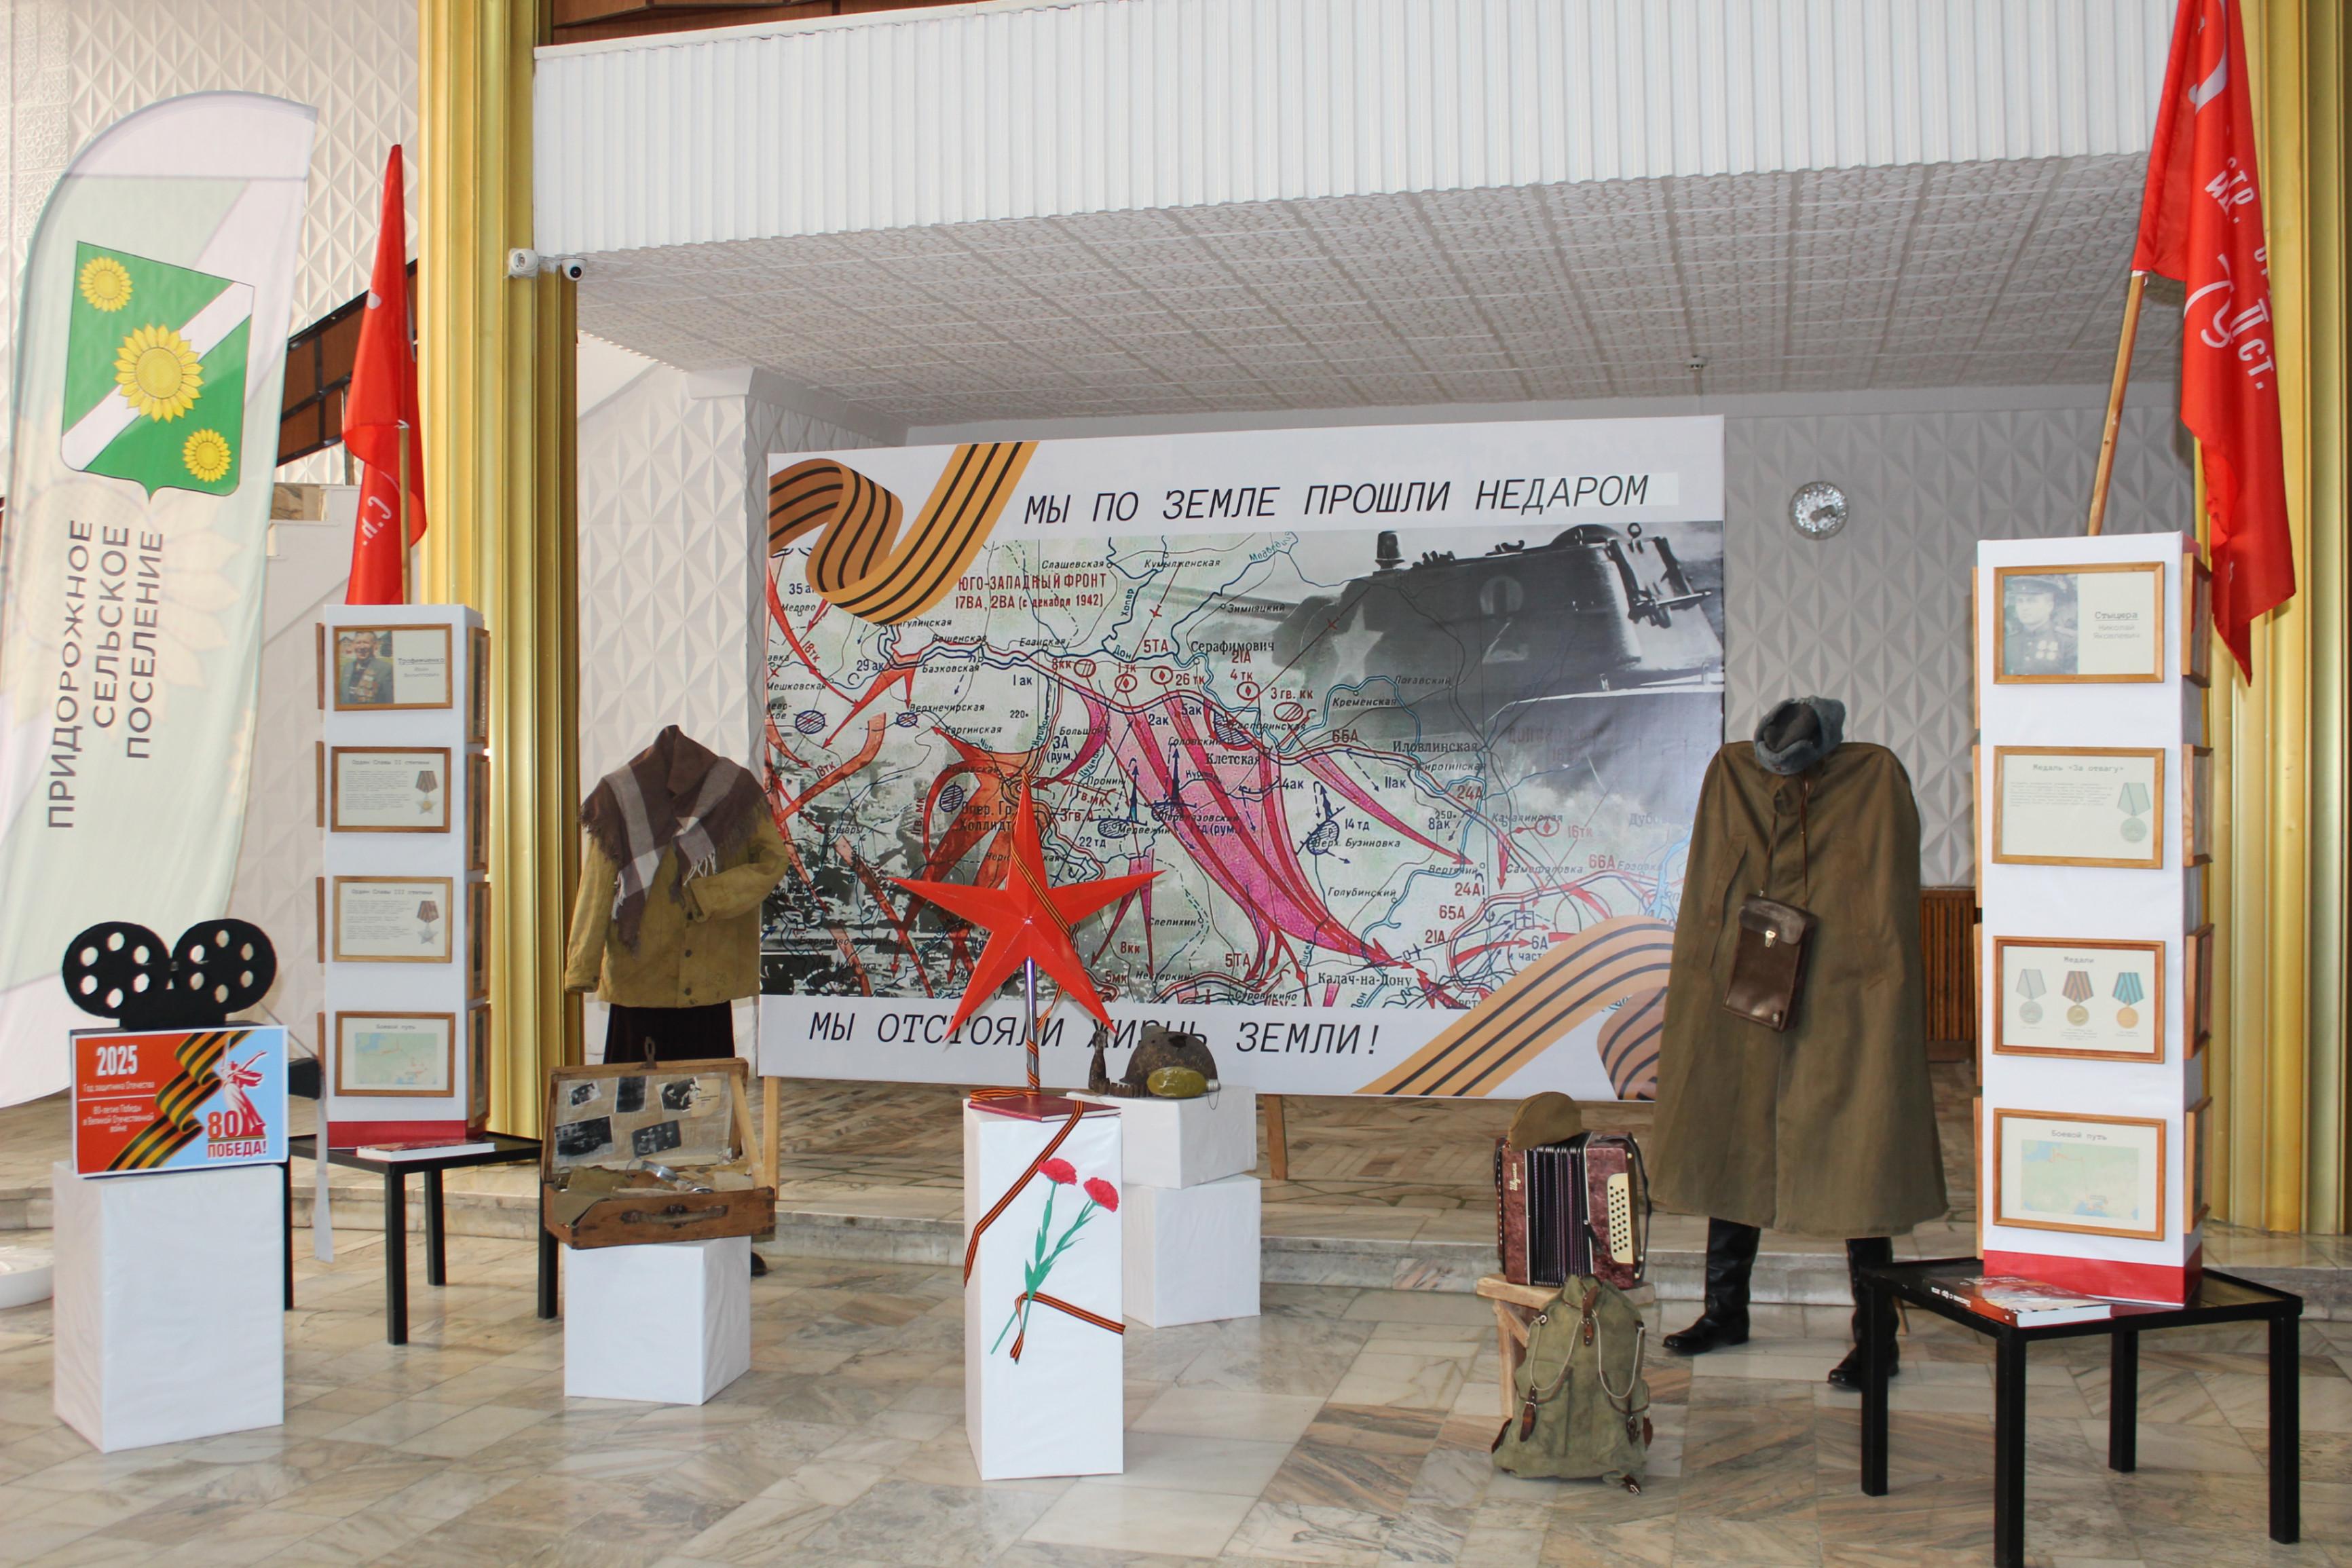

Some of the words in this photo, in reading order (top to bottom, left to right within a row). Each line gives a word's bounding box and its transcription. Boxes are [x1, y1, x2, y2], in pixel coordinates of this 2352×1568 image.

[1024, 494, 1071, 524] МЫ
[1092, 491, 1140, 522] ПО
[1163, 486, 1281, 521] ЗЕМЛЕ
[1304, 481, 1451, 515] ПРОШЛИ
[1474, 474, 1649, 515] НЕДАРОМ
[789, 583, 802, 594] 35
[958, 573, 1061, 591] ЮГО-ЗАПАДНЫЙ
[1064, 572, 1107, 589] ФРОНТ
[990, 595, 1015, 610] 2ВА
[1031, 594, 1070, 609] декабря
[1076, 592, 1103, 609] 1942)
[93, 525, 130, 728] СЕЛЬСКОЕ
[126, 531, 164, 759] ПОСЕЛЕНИЕ
[1113, 645, 1132, 660] Дон
[1143, 639, 1169, 654] 5ТА
[1191, 640, 1275, 654] Серафимович
[856, 660, 868, 671] 29
[48, 520, 93, 829] ПРИДОРОЖНОЕ
[1175, 673, 1190, 686] 26
[1332, 697, 1398, 707] Кременская
[1148, 714, 1170, 726] 2ак
[1393, 741, 1478, 753] Иловлинская
[1206, 753, 1261, 766] Клетская
[1079, 837, 1092, 847] 22
[1588, 854, 1616, 869] 66А
[1328, 886, 1396, 897] Голубинский
[1455, 882, 1480, 896] 24А
[1439, 904, 1466, 919] 65А
[1425, 929, 1446, 944] 21А
[1531, 935, 1549, 950] 6А
[1225, 953, 1250, 967] 5ТА
[1318, 971, 1412, 987] Калач-на-Дону
[808, 1011, 856, 1042] МЫ
[96, 1045, 138, 1077] 2025
[206, 1110, 240, 1139] 80
[207, 1140, 267, 1159] ПОБЕДА!
